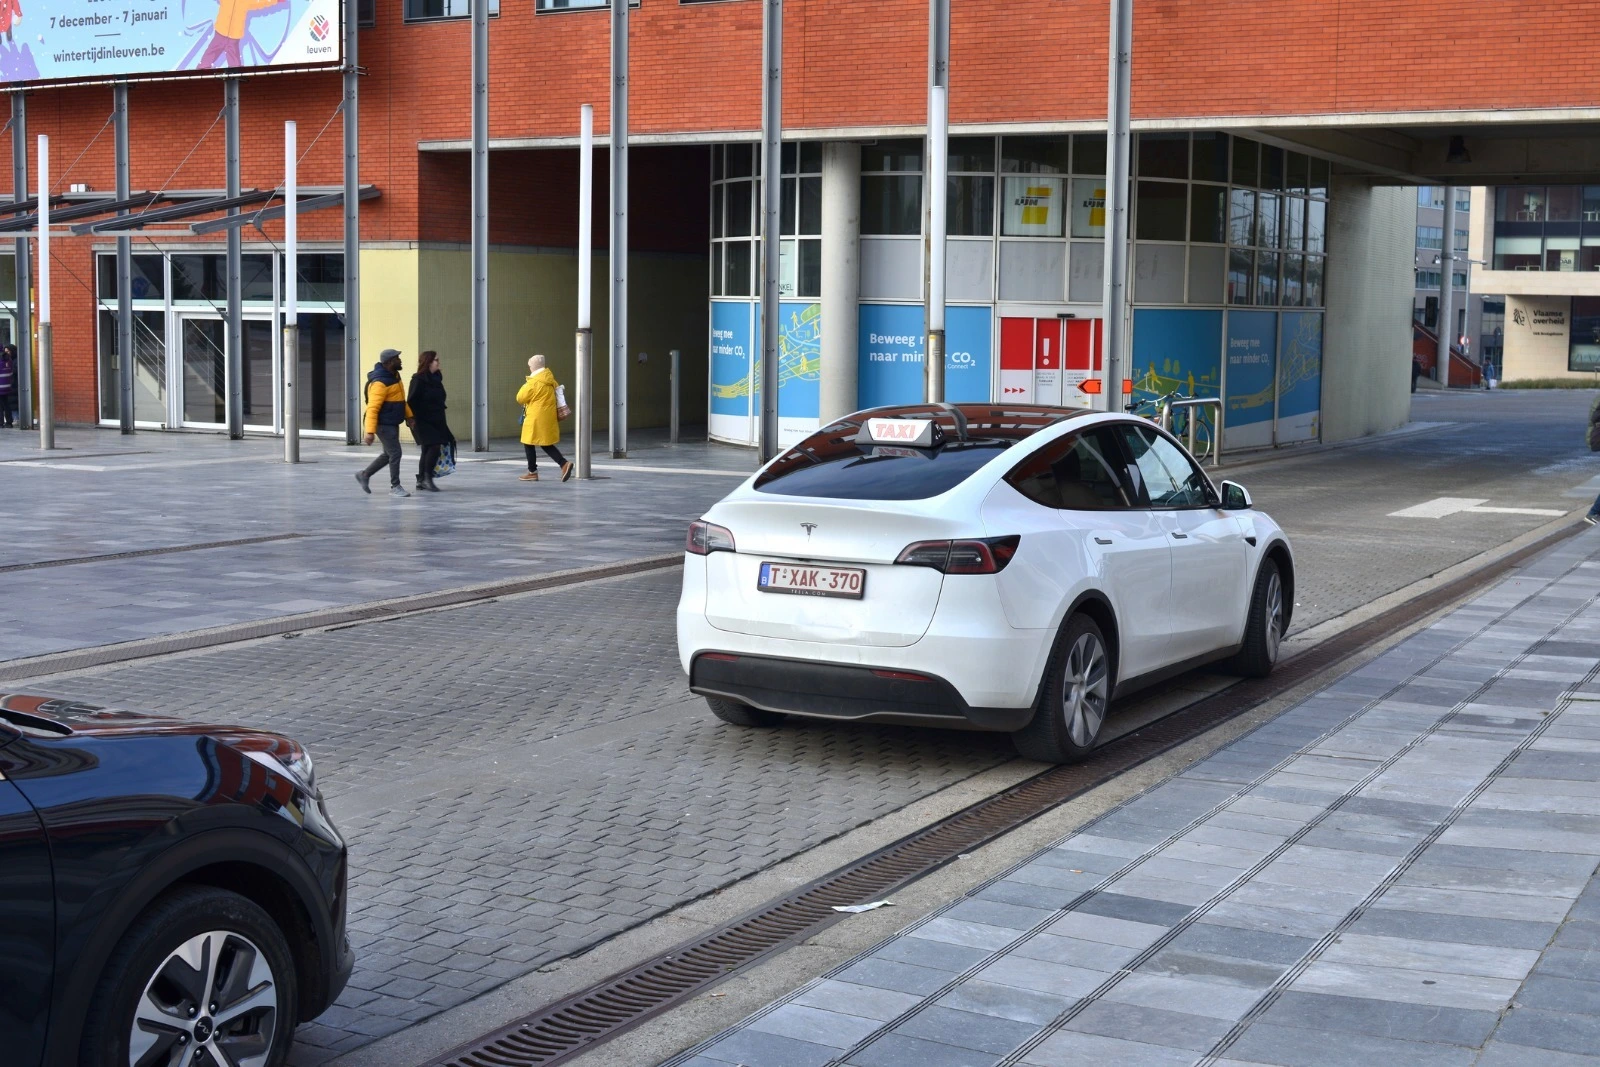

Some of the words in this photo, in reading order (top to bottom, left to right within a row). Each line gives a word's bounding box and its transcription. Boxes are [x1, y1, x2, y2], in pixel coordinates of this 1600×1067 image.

[50, 17, 56, 29] 7
[59, 13, 112, 28] december
[123, 11, 129, 23] 7
[131, 7, 168, 26] januari
[54, 43, 165, 63] wintertijdinleuven.be
[307, 45, 332, 54] leuven
[869, 333, 916, 347] Beweeg
[869, 352, 898, 362] naar
[875, 424, 917, 439] TAXI
[761, 577, 768, 585] B
